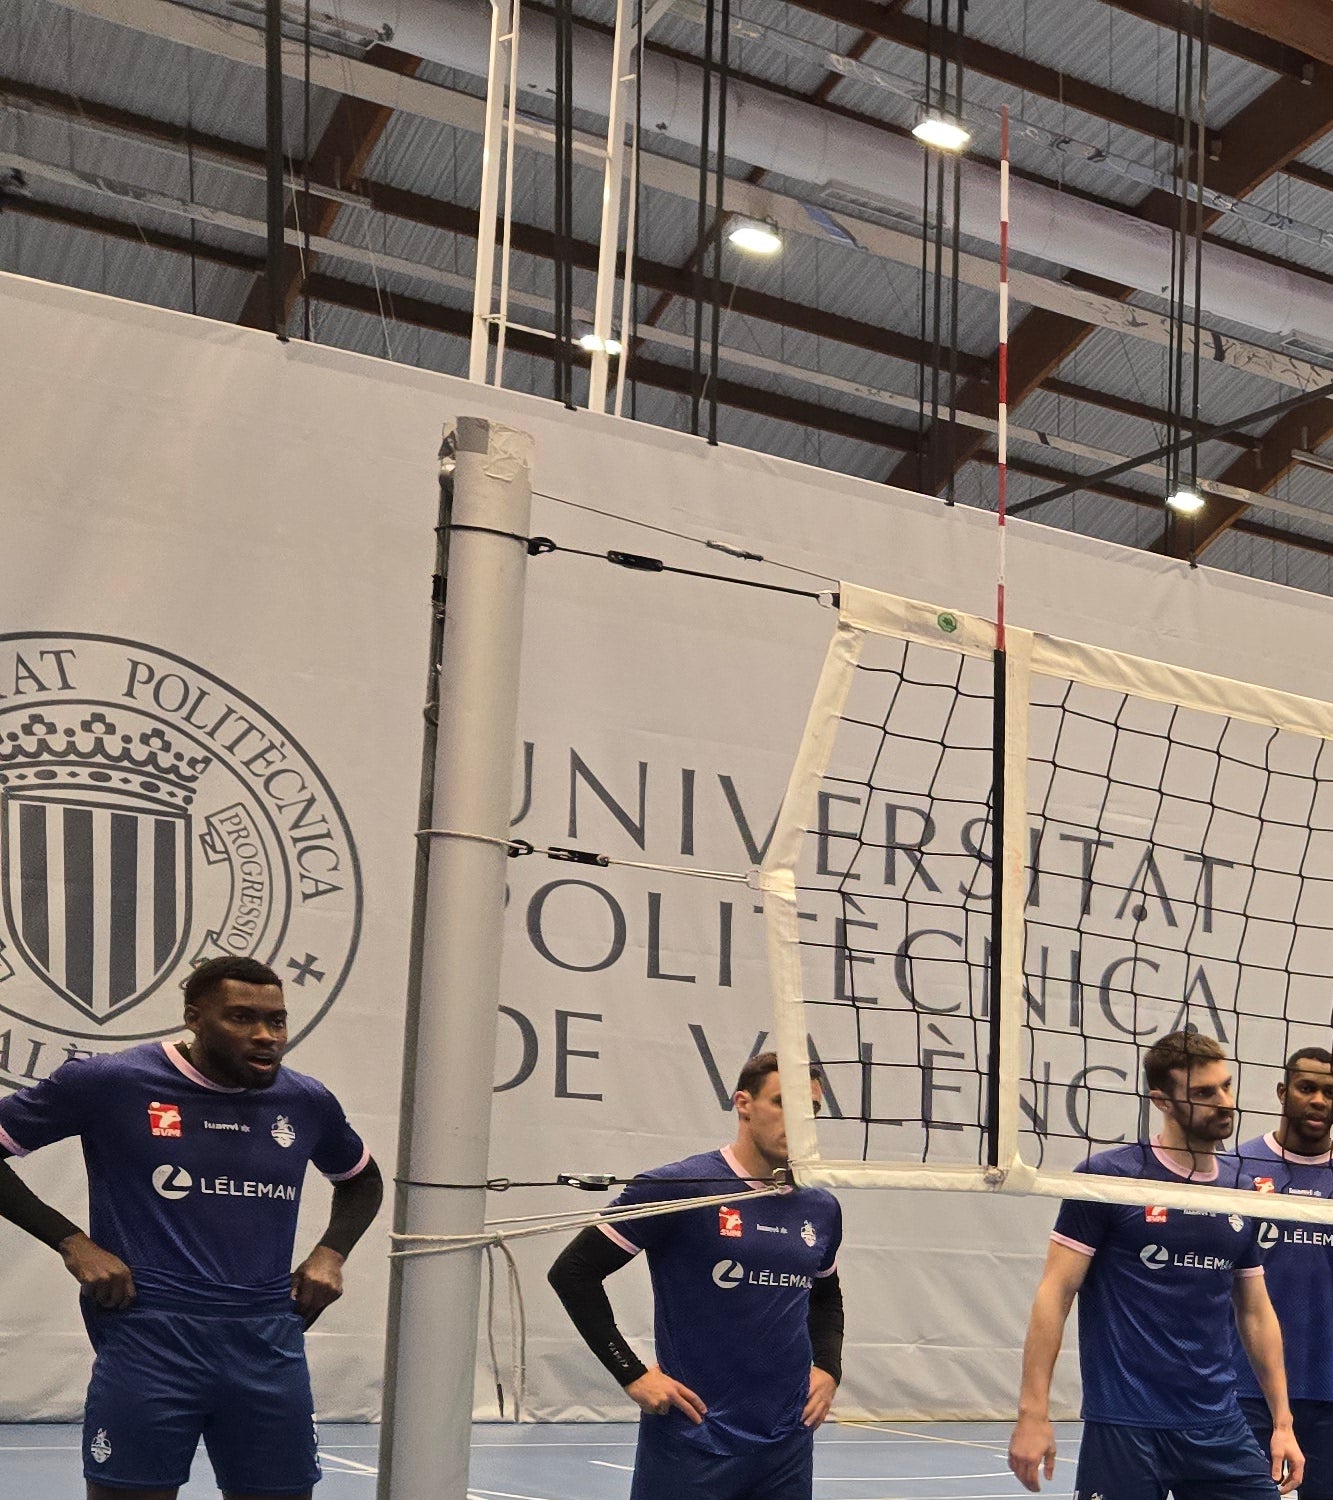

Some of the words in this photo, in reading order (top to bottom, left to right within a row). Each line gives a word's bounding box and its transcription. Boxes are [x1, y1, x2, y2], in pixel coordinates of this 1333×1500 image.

[122, 657, 344, 903] POLITÈCNICA
[218, 811, 265, 951] PROGRESSIO
[505, 878, 1230, 1044] OLIÈCNICA
[152, 1128, 181, 1137] SVM
[201, 1176, 296, 1200] LÉLEMAN
[1173, 1251, 1233, 1271] LÉLEM
